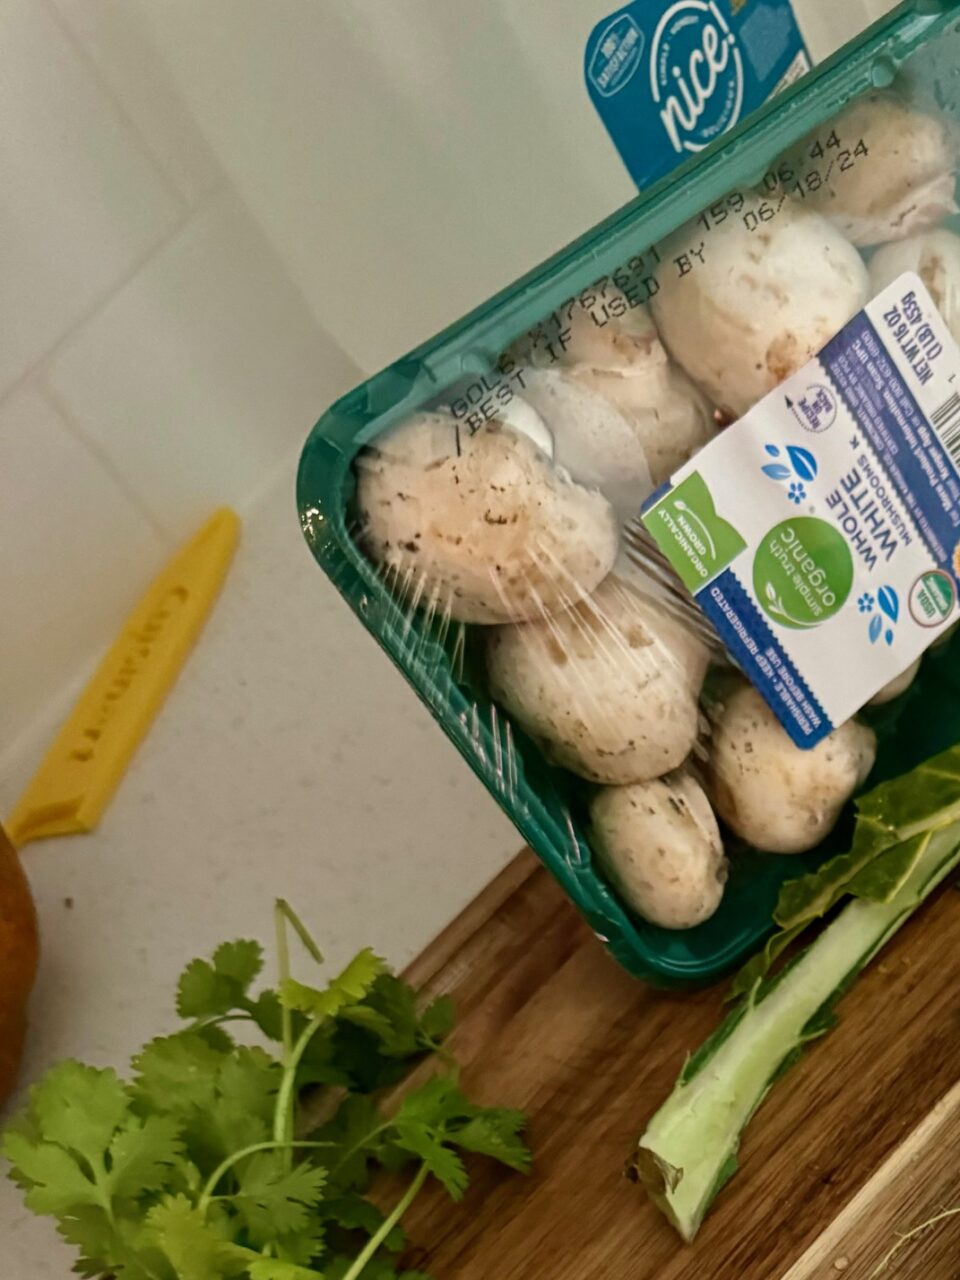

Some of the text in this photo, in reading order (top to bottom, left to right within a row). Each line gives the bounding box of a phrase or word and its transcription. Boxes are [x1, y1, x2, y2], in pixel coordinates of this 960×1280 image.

[541, 327, 570, 362] IF
[589, 274, 661, 328] USED
[672, 241, 705, 278] BY
[741, 138, 870, 231] 06/18/24
[882, 305, 933, 386] NET WT 16 OZ
[900, 290, 922, 324] 453g
[864, 360, 885, 391] Scan
[856, 453, 912, 545] MUSHROOMS
[912, 446, 940, 487] Product
[934, 483, 953, 512] More
[657, 508, 709, 578] ORGANICALLY
[676, 514, 707, 555] GROWN
[824, 489, 876, 571] WHOLE
[839, 468, 897, 561] WHITE
[767, 539, 823, 616] simple truth
[778, 525, 836, 608] organic
[915, 588, 936, 618] USDA
[709, 586, 813, 735] PERISHABLE KEEP REFRIGERATED
[764, 646, 821, 727] WASH BEFORE USE
